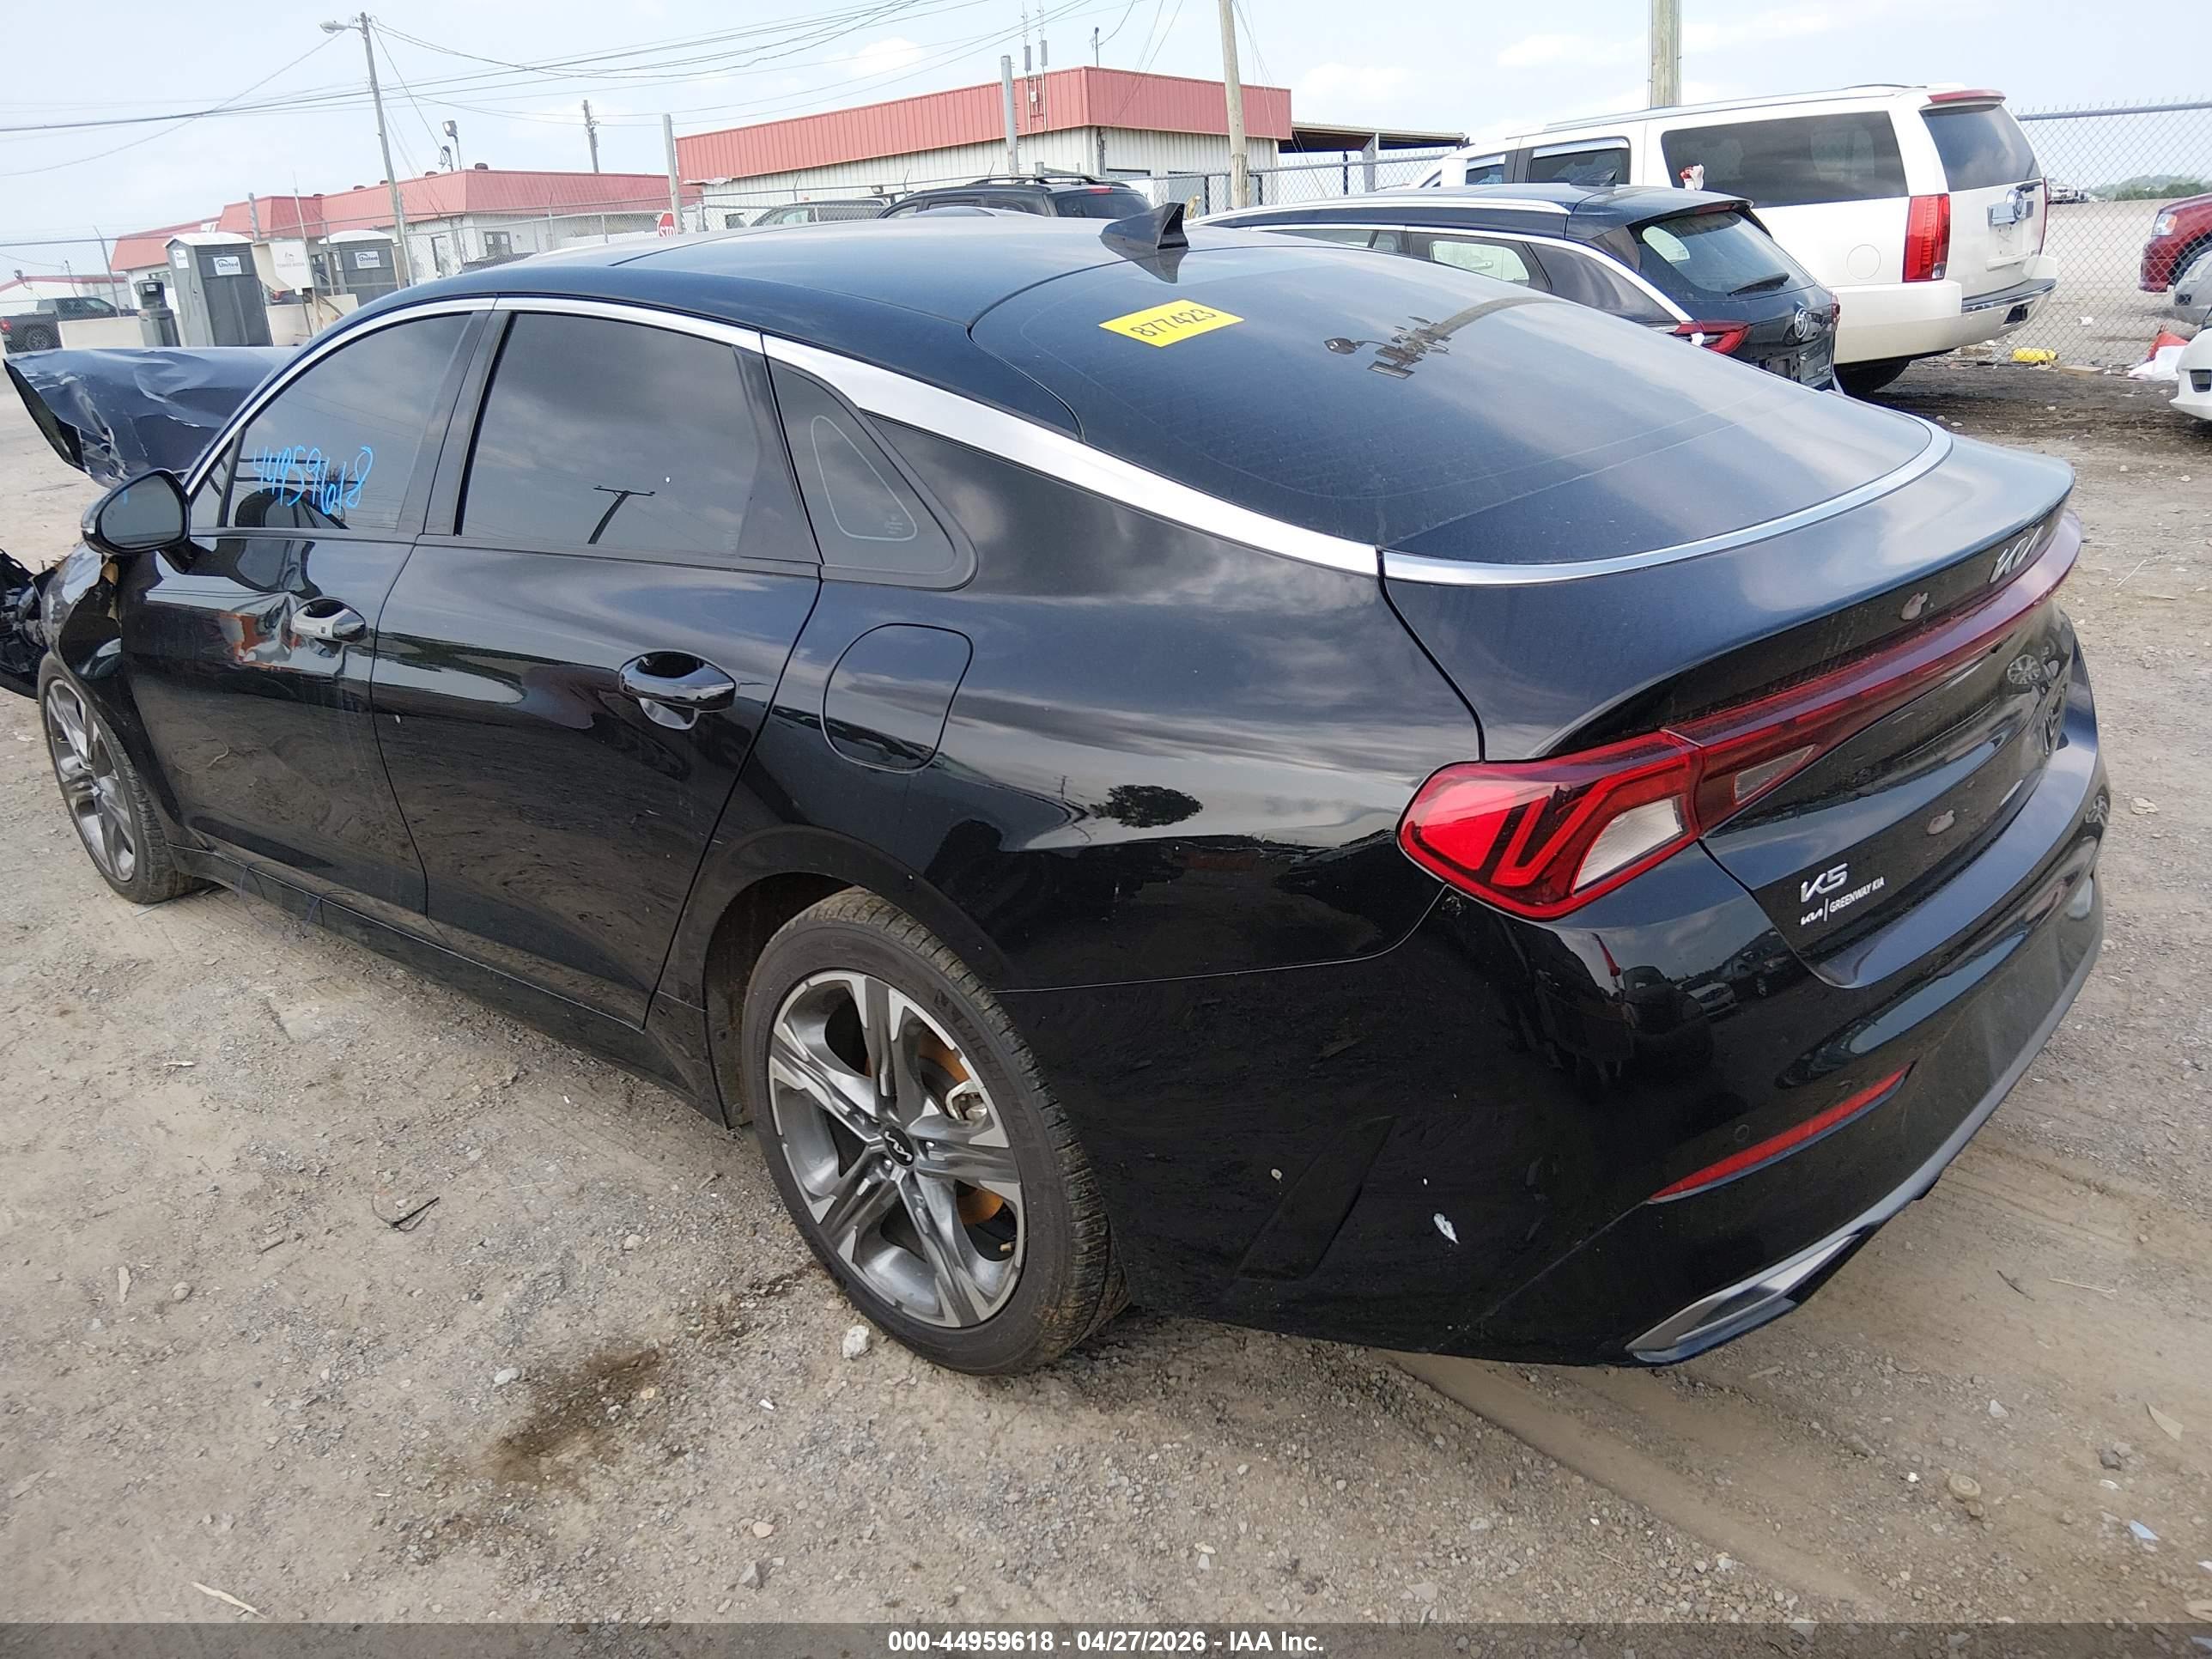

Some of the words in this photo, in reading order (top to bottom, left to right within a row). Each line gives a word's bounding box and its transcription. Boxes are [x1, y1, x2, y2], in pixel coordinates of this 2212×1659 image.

[659, 225, 676, 237] STO
[1129, 308, 1217, 337] 877423
[253, 445, 374, 515] 44959618
[1800, 862, 1849, 903] K5
[1829, 882, 1872, 913] GREENWAY
[1872, 876, 1885, 891] KIA
